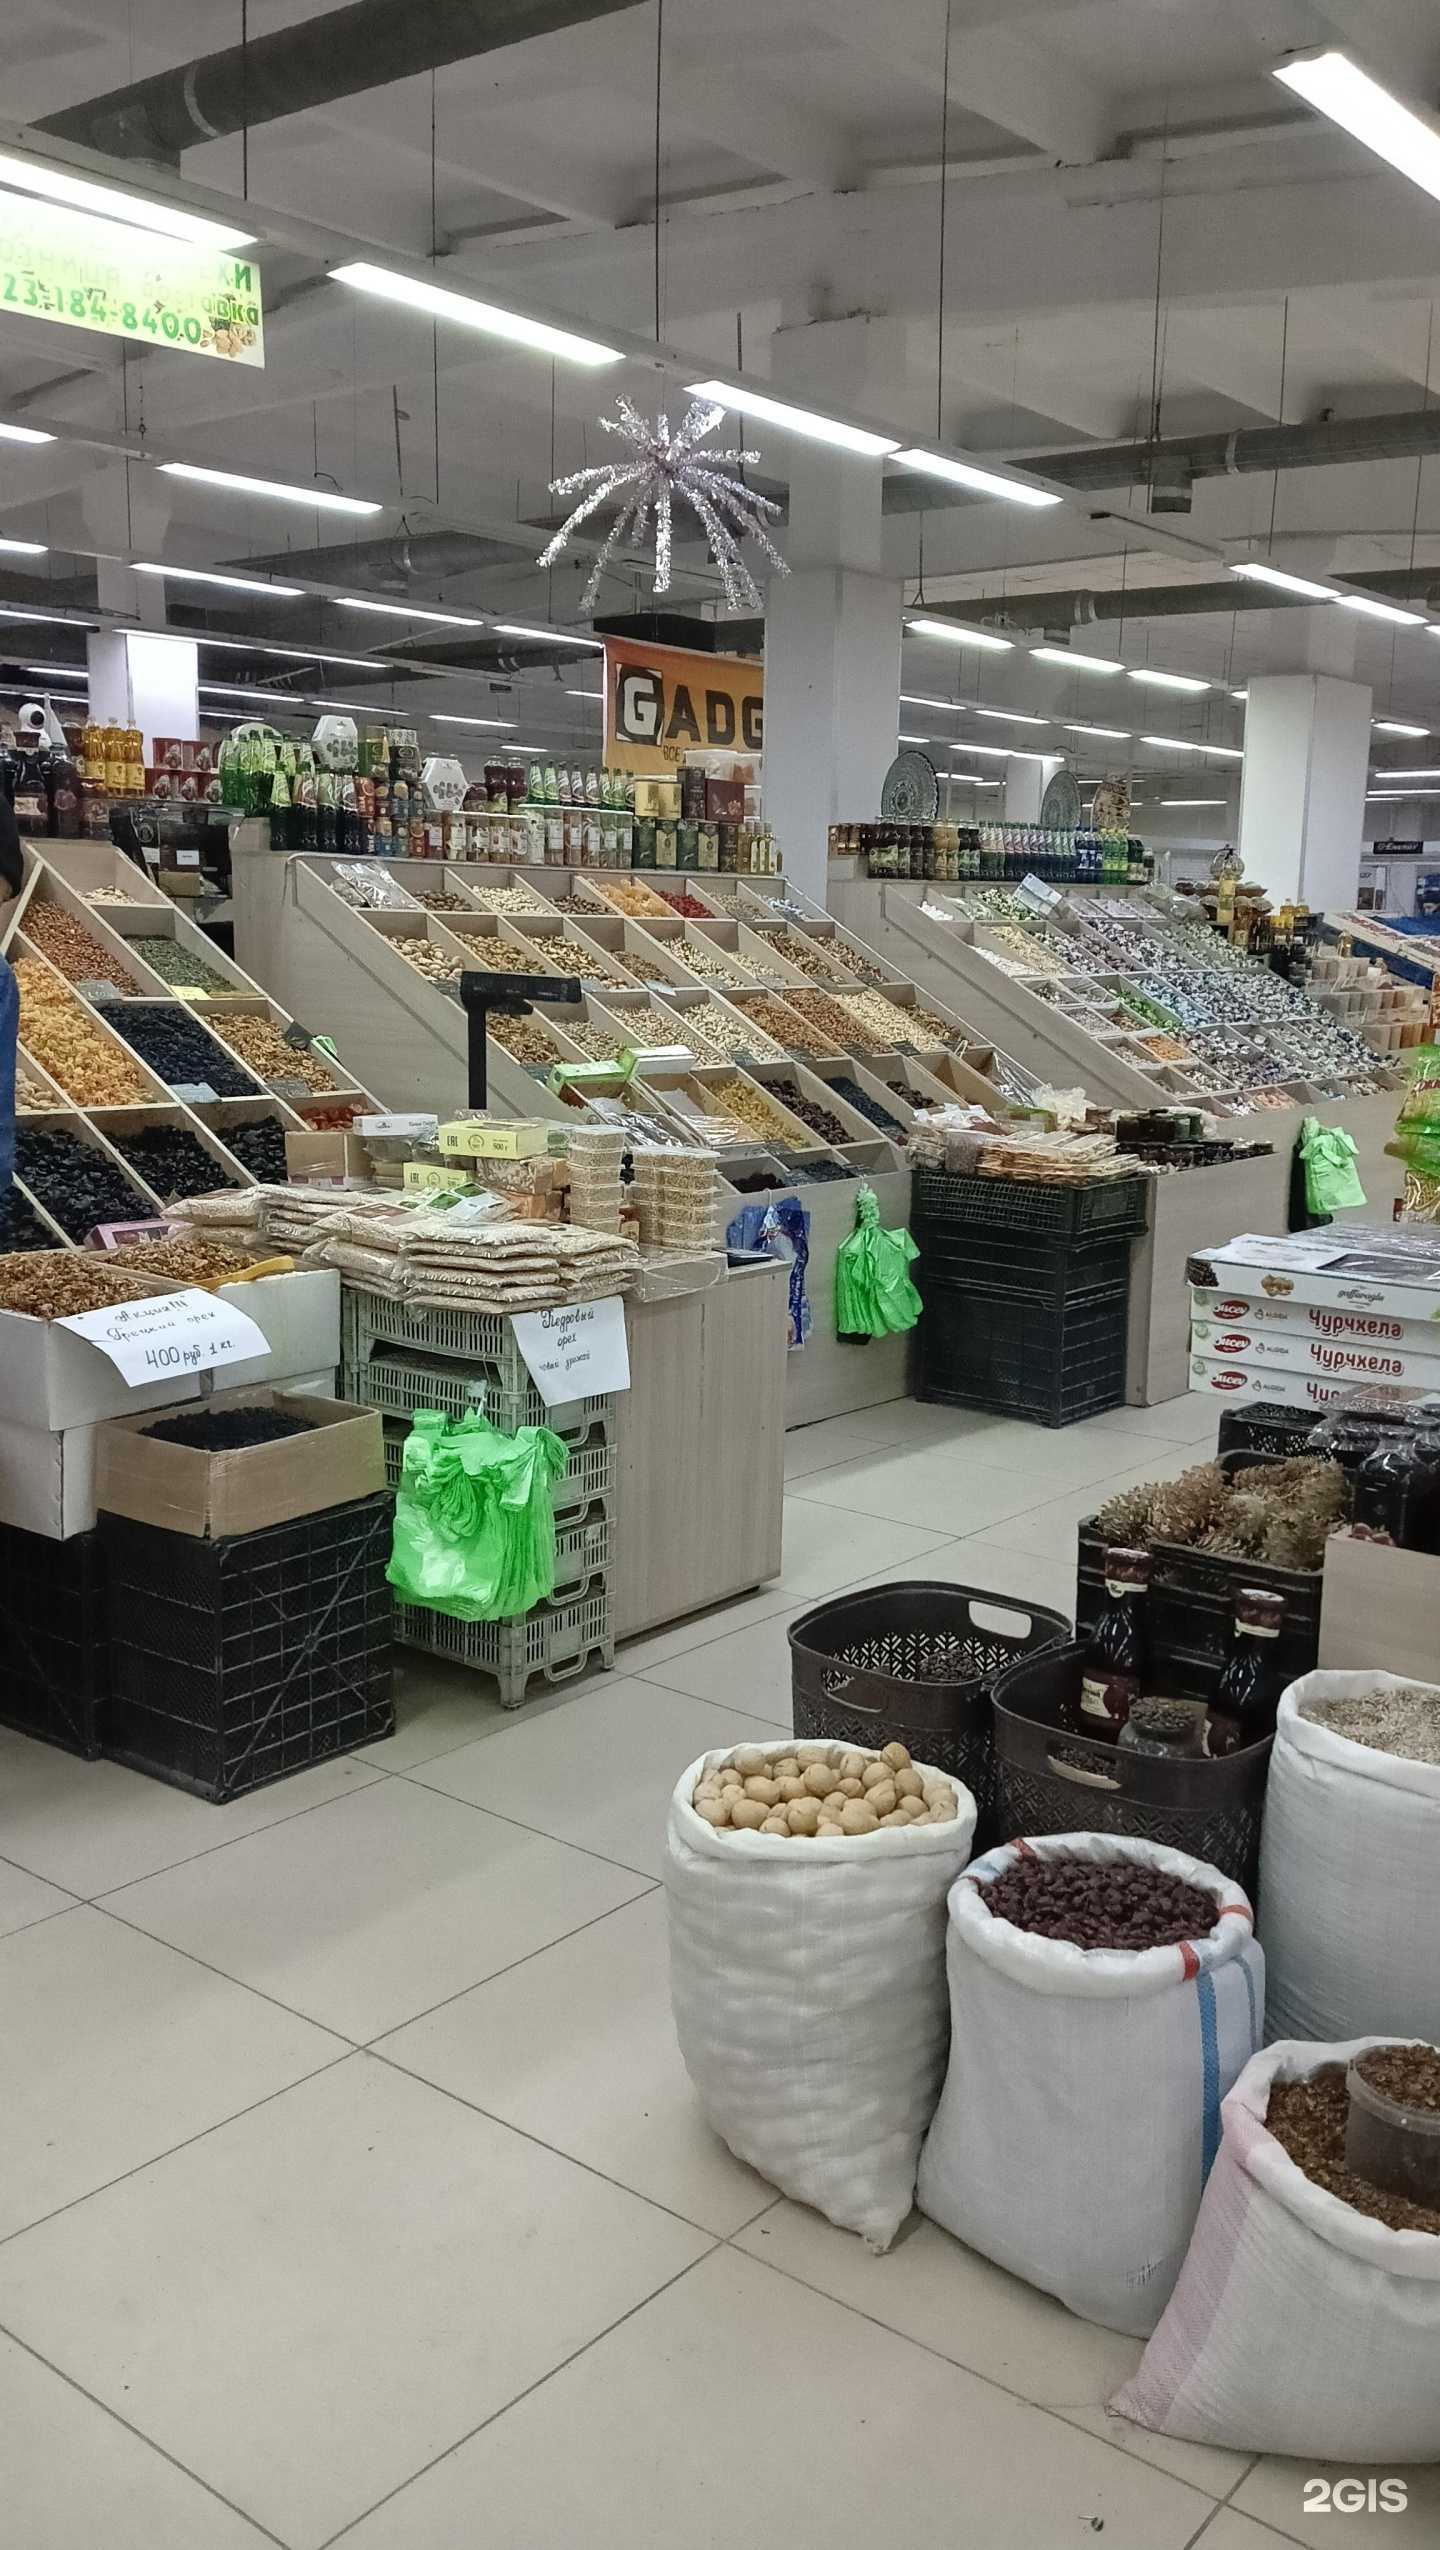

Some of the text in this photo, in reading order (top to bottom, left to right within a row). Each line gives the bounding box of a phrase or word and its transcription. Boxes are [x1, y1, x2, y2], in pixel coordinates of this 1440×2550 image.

[1308, 1308, 1404, 1340] Чурчхела
[557, 1333, 577, 1351] орех
[145, 1346, 180, 1368] 400
[1309, 1343, 1405, 1376] Чурчхела
